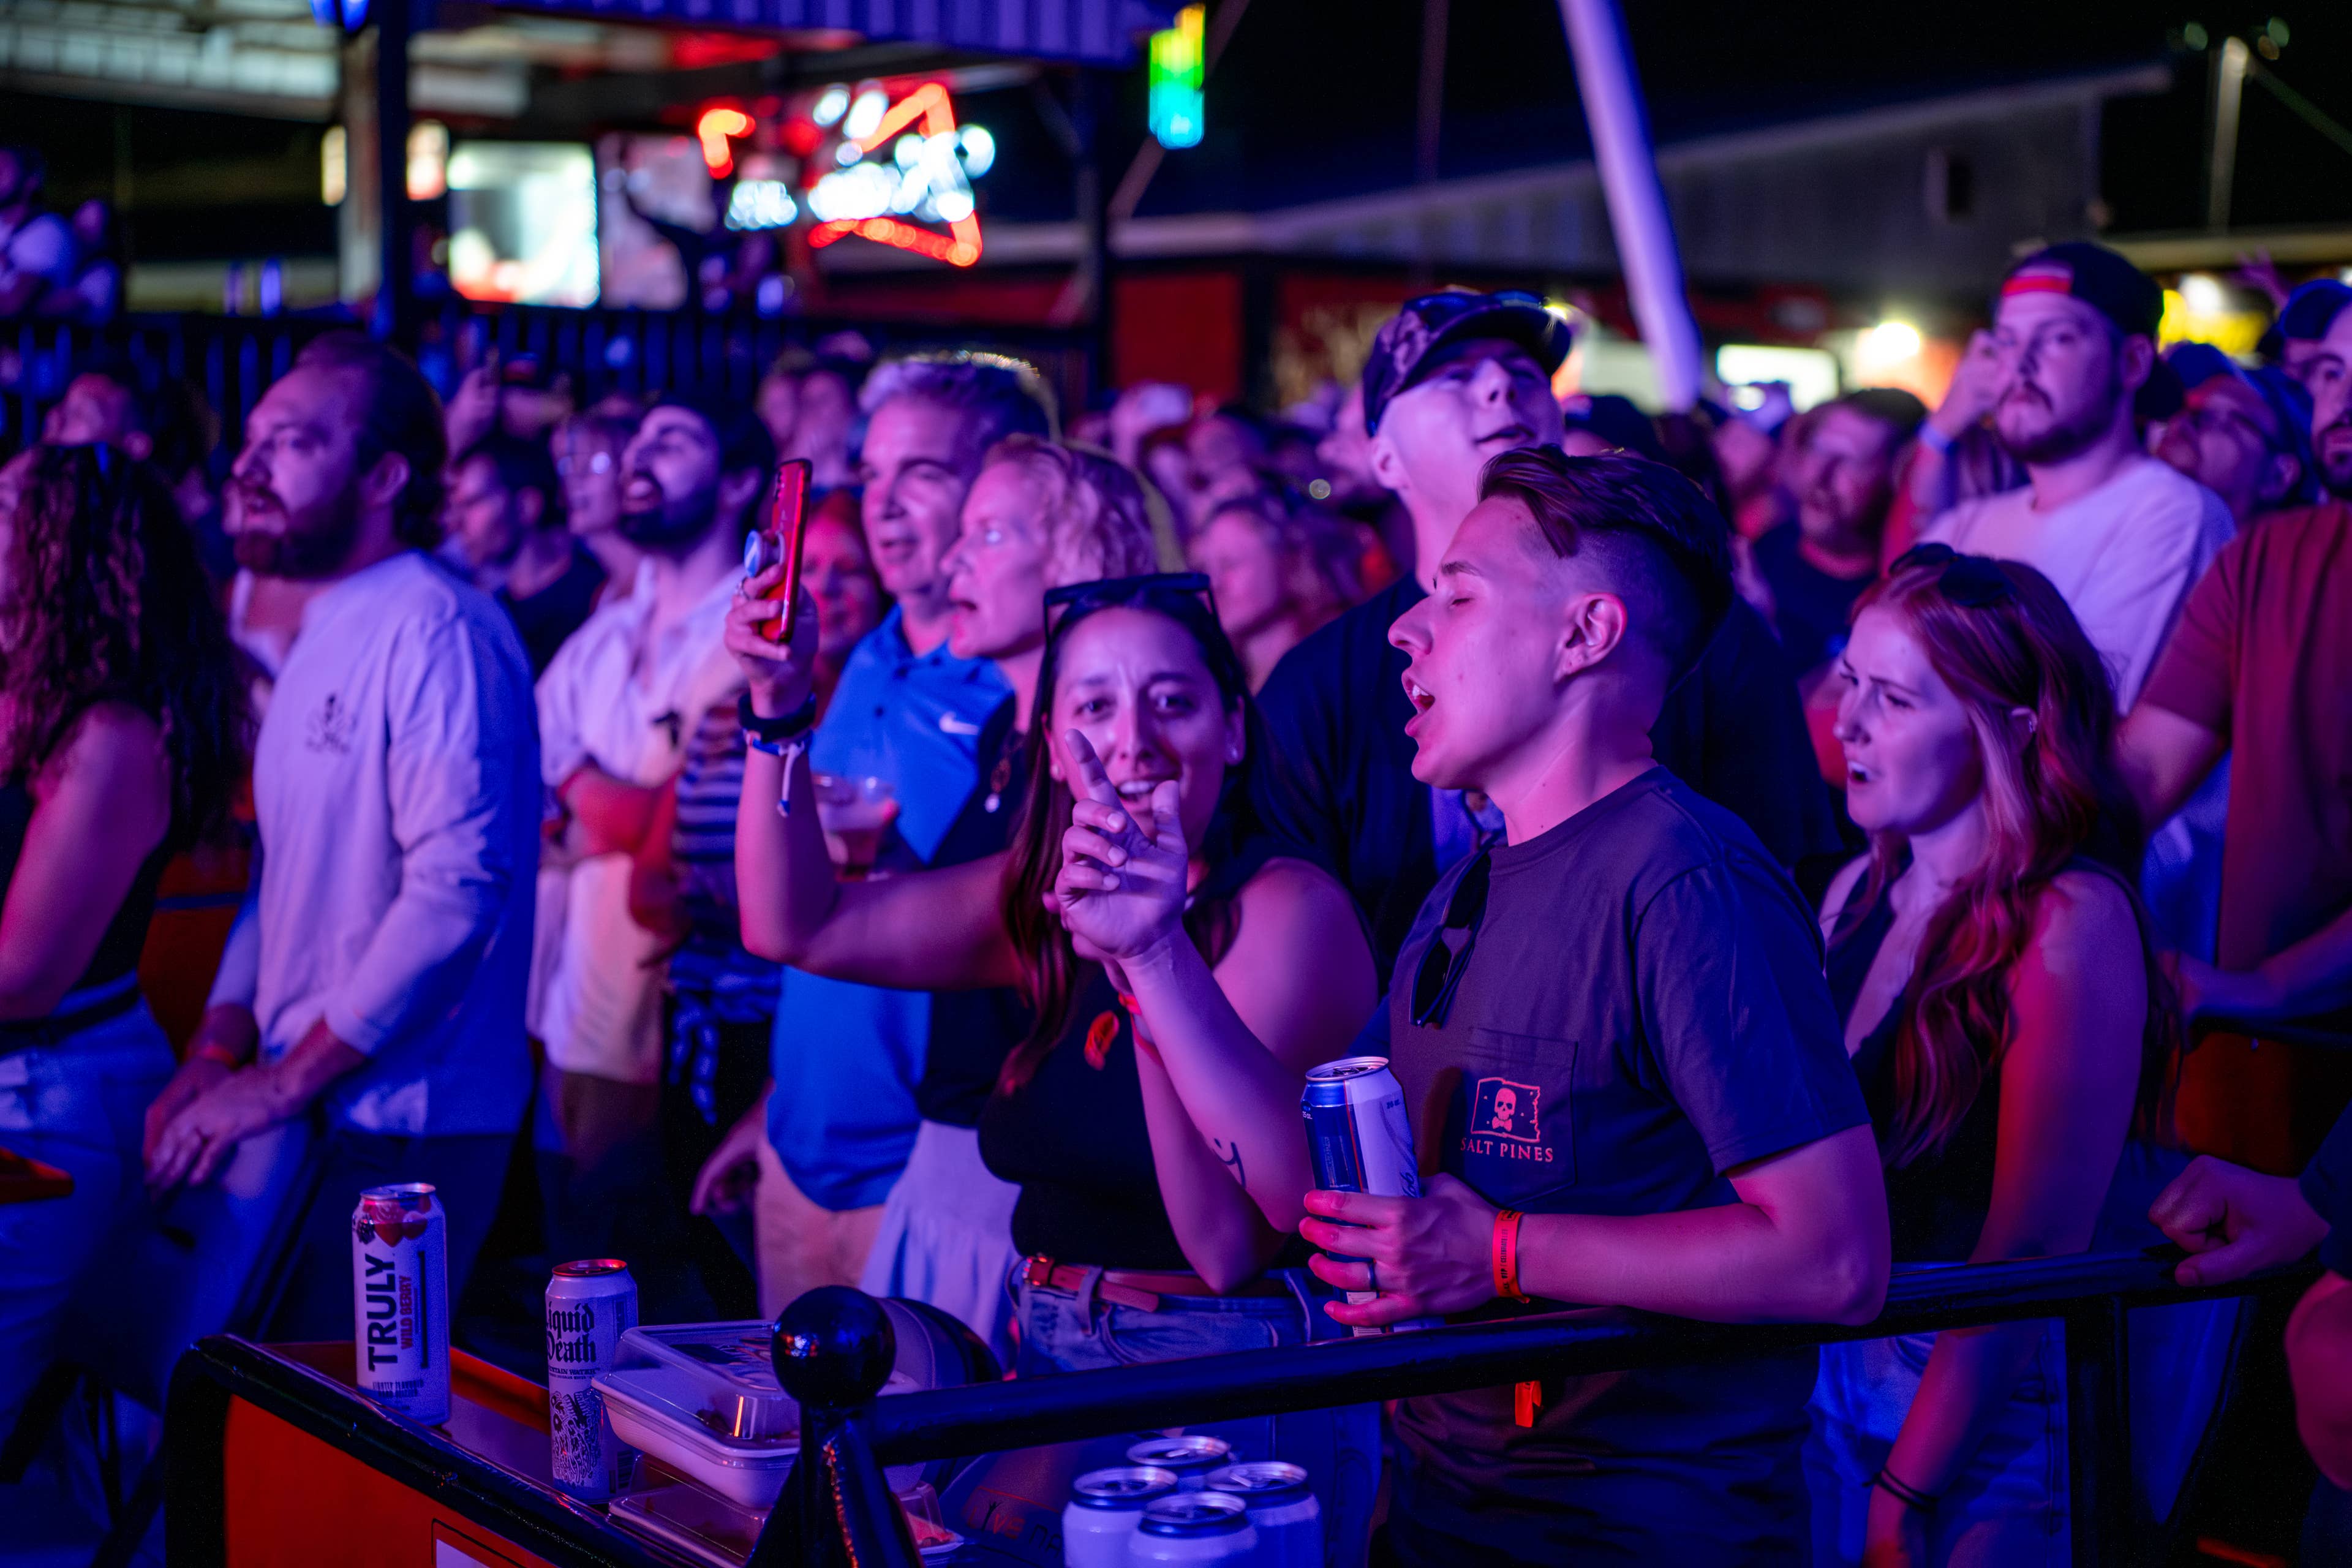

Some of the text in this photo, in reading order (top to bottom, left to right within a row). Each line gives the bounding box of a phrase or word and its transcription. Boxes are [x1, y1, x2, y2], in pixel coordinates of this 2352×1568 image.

[1460, 1137, 1553, 1163] SALT PINES
[365, 1253, 398, 1372] TRULY
[399, 1275, 413, 1350] WILD BERRY
[546, 1301, 595, 1340] iquid
